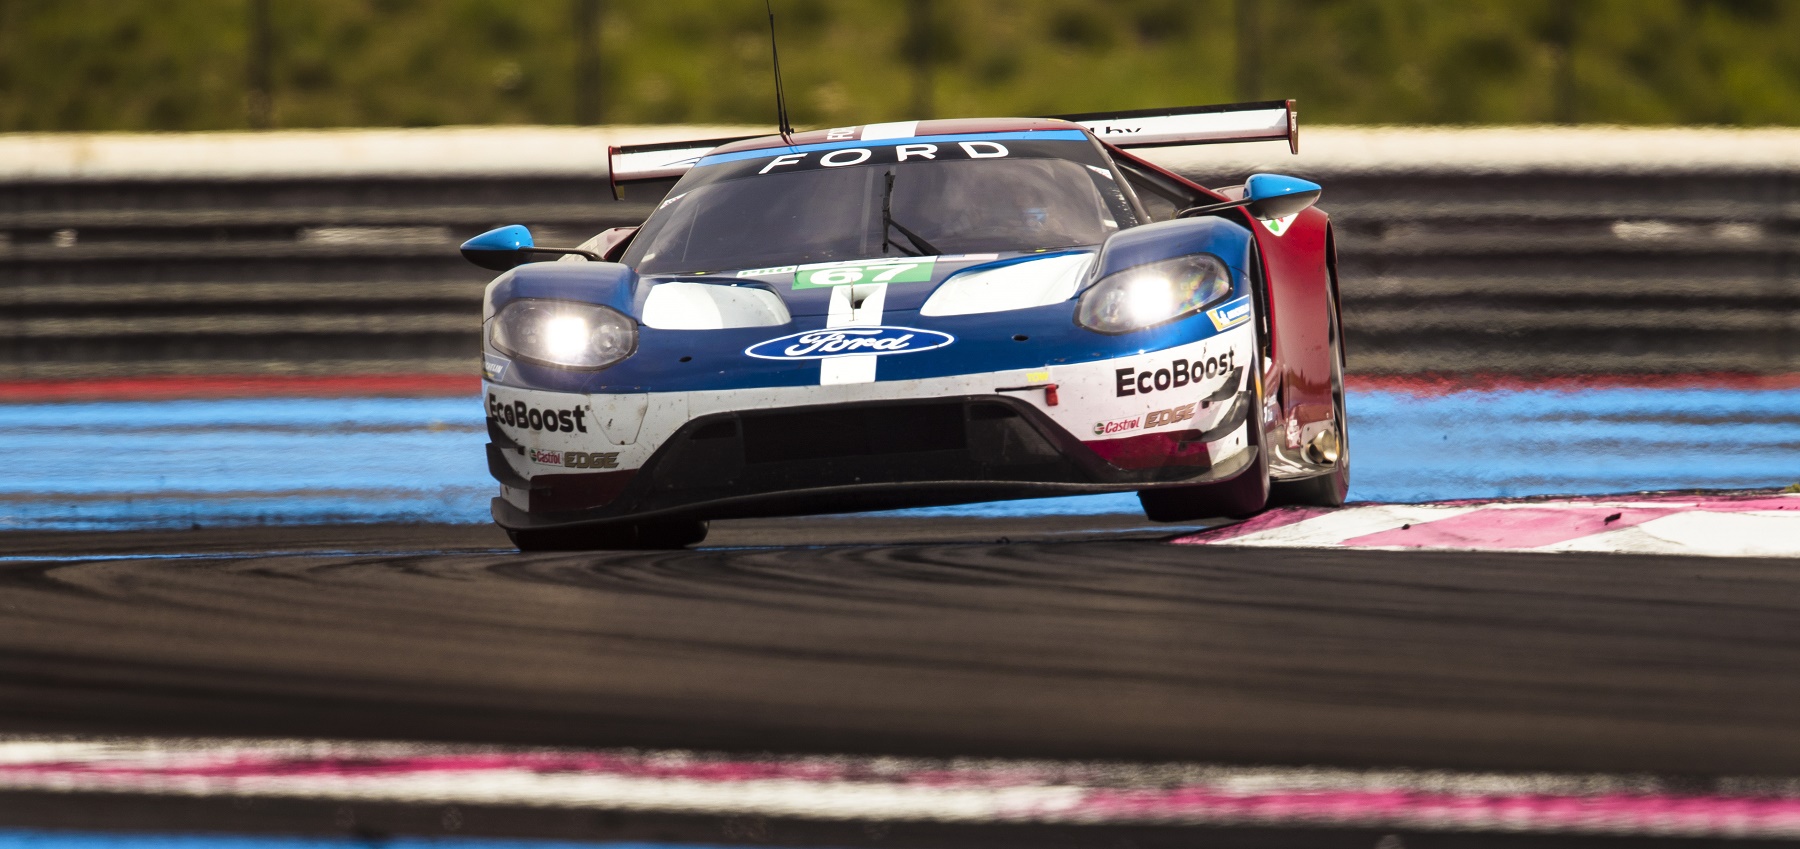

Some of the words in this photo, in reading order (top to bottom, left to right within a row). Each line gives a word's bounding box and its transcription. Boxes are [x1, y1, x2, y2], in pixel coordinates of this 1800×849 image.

[827, 126, 857, 140] FO
[758, 141, 1009, 174] FORD
[810, 263, 919, 286] 67
[784, 329, 914, 357] Ford
[1115, 350, 1235, 398] EcoBoost
[489, 393, 588, 434] EcoBoost
[1104, 417, 1141, 434] Castrol
[1143, 402, 1198, 429] EDGE
[535, 450, 561, 465] Castrol
[564, 451, 620, 469] EDGE
